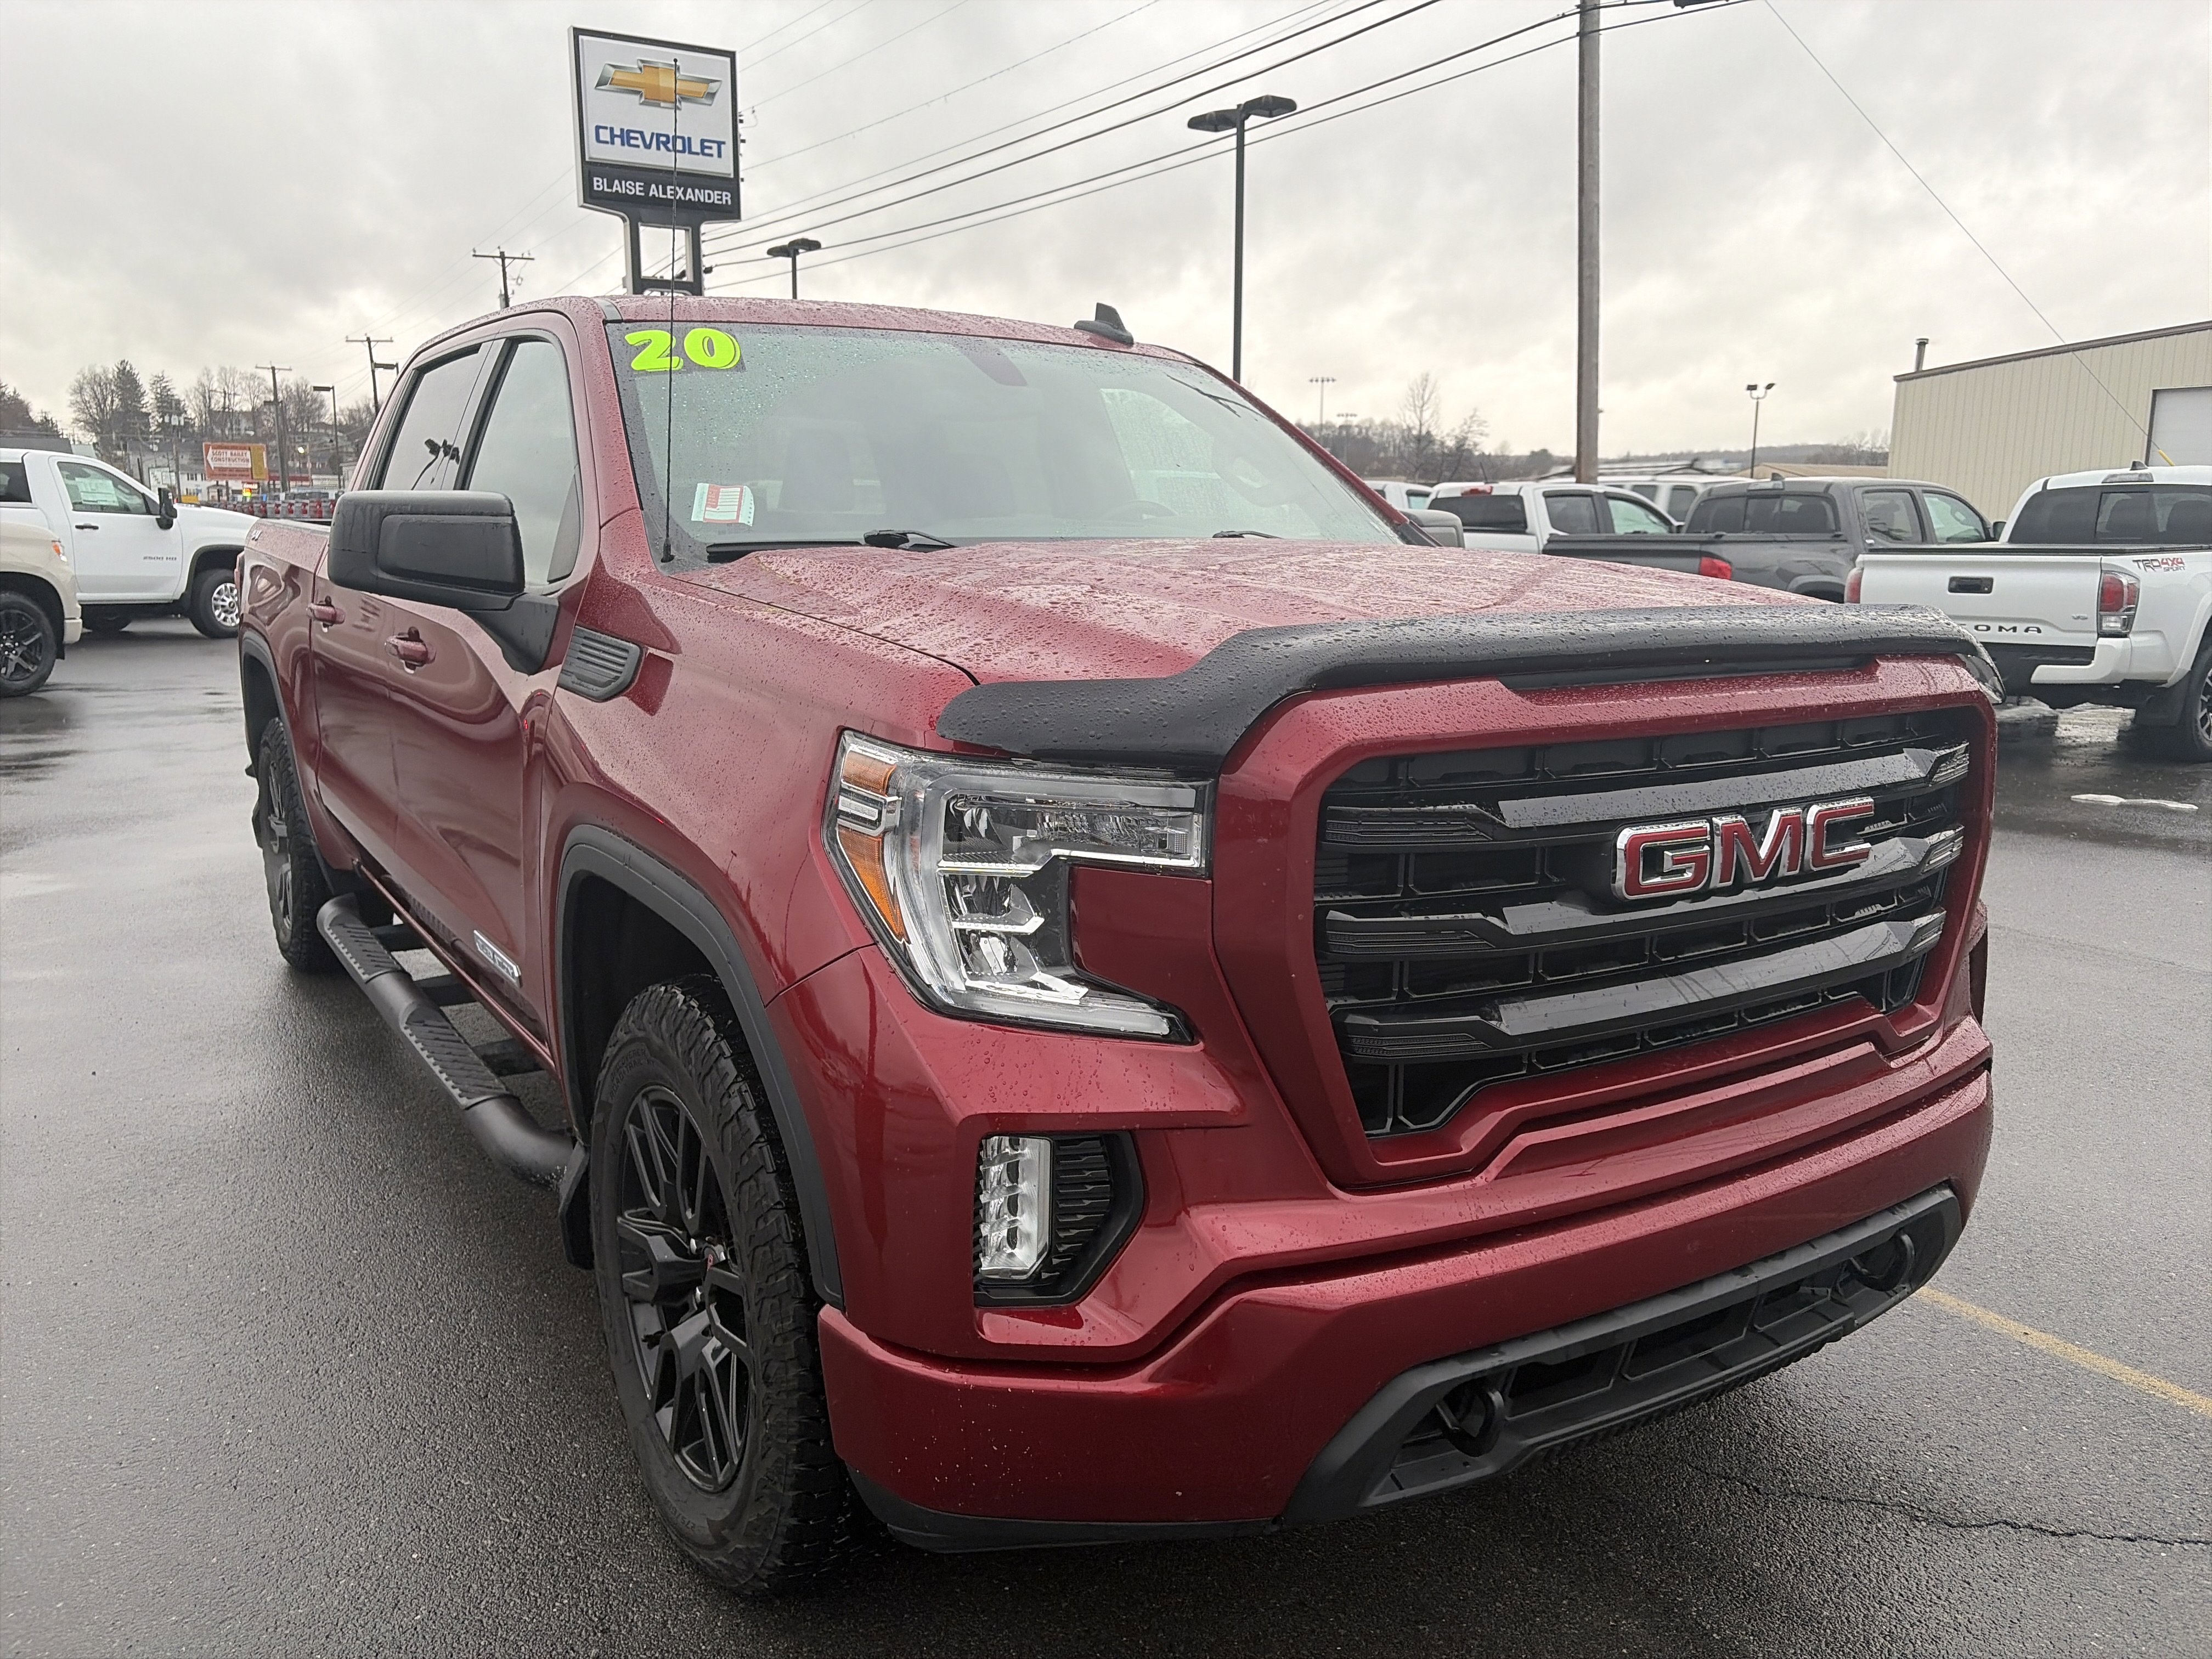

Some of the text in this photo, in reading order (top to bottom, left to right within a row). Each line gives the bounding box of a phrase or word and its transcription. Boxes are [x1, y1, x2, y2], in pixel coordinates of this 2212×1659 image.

[595, 125, 726, 158] CHEVROLET
[593, 177, 731, 205] BLAISE ALEXANDER
[624, 328, 741, 372] 20
[1959, 623, 2042, 634] OMA
[1611, 796, 1874, 900] GMC
